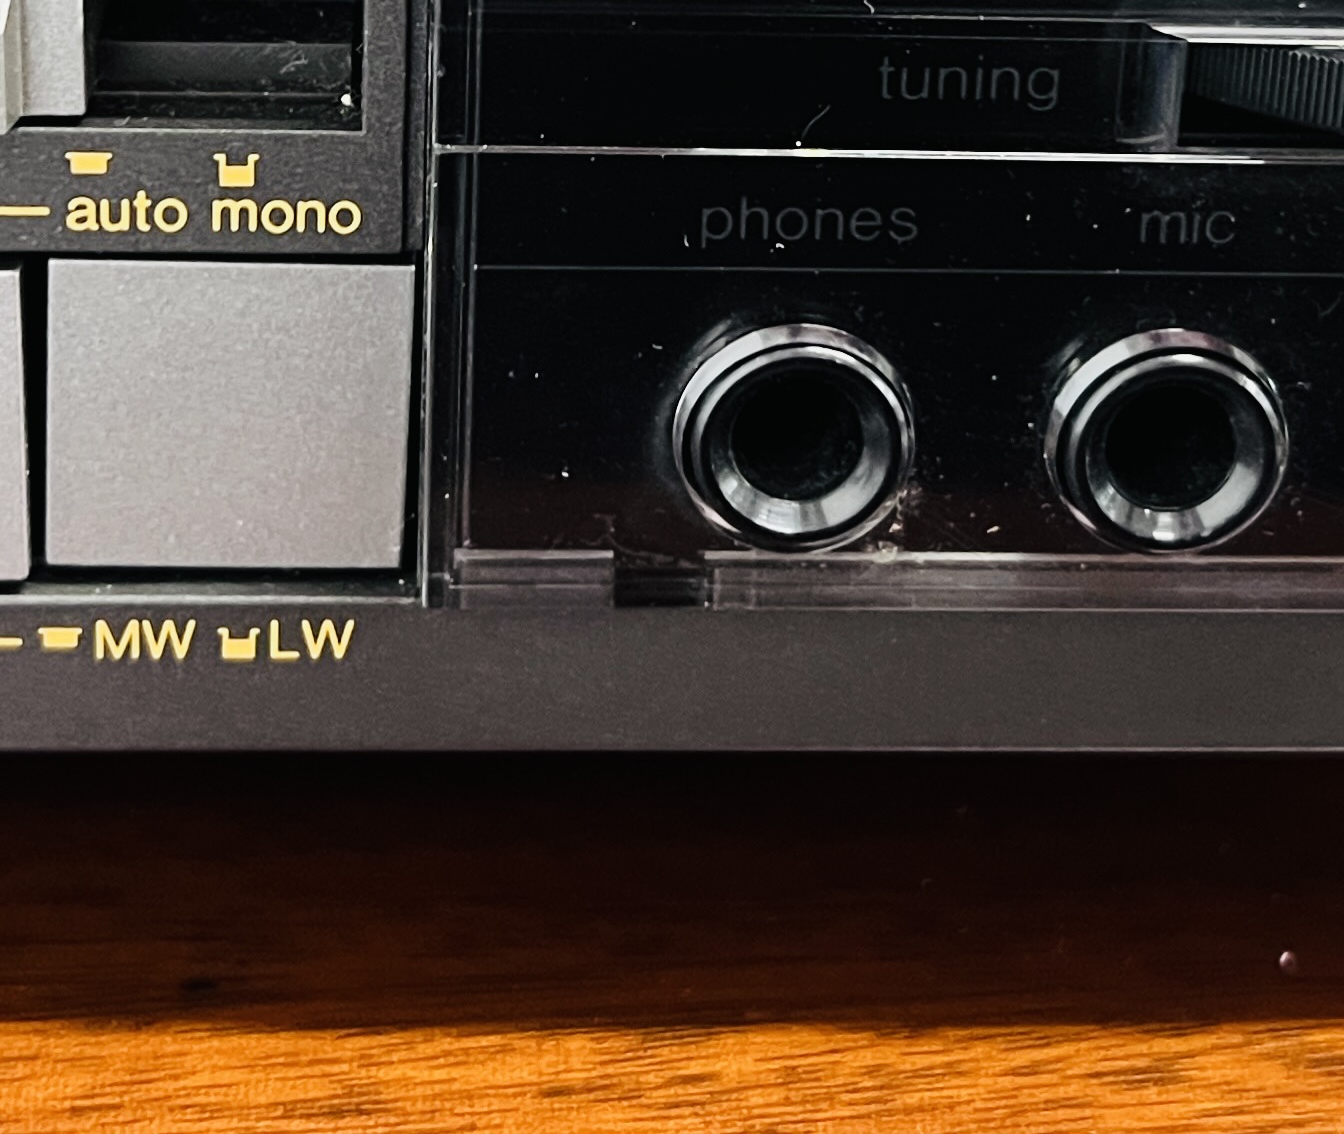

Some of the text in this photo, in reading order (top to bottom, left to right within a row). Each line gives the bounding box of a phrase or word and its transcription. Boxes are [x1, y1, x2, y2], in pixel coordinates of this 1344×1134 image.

[879, 54, 1060, 110] tuning
[64, 189, 188, 233] auto
[211, 196, 362, 235] mono
[699, 196, 919, 250] phones
[1138, 208, 1237, 245] mic
[93, 619, 196, 662] MW
[269, 619, 355, 661] LW
